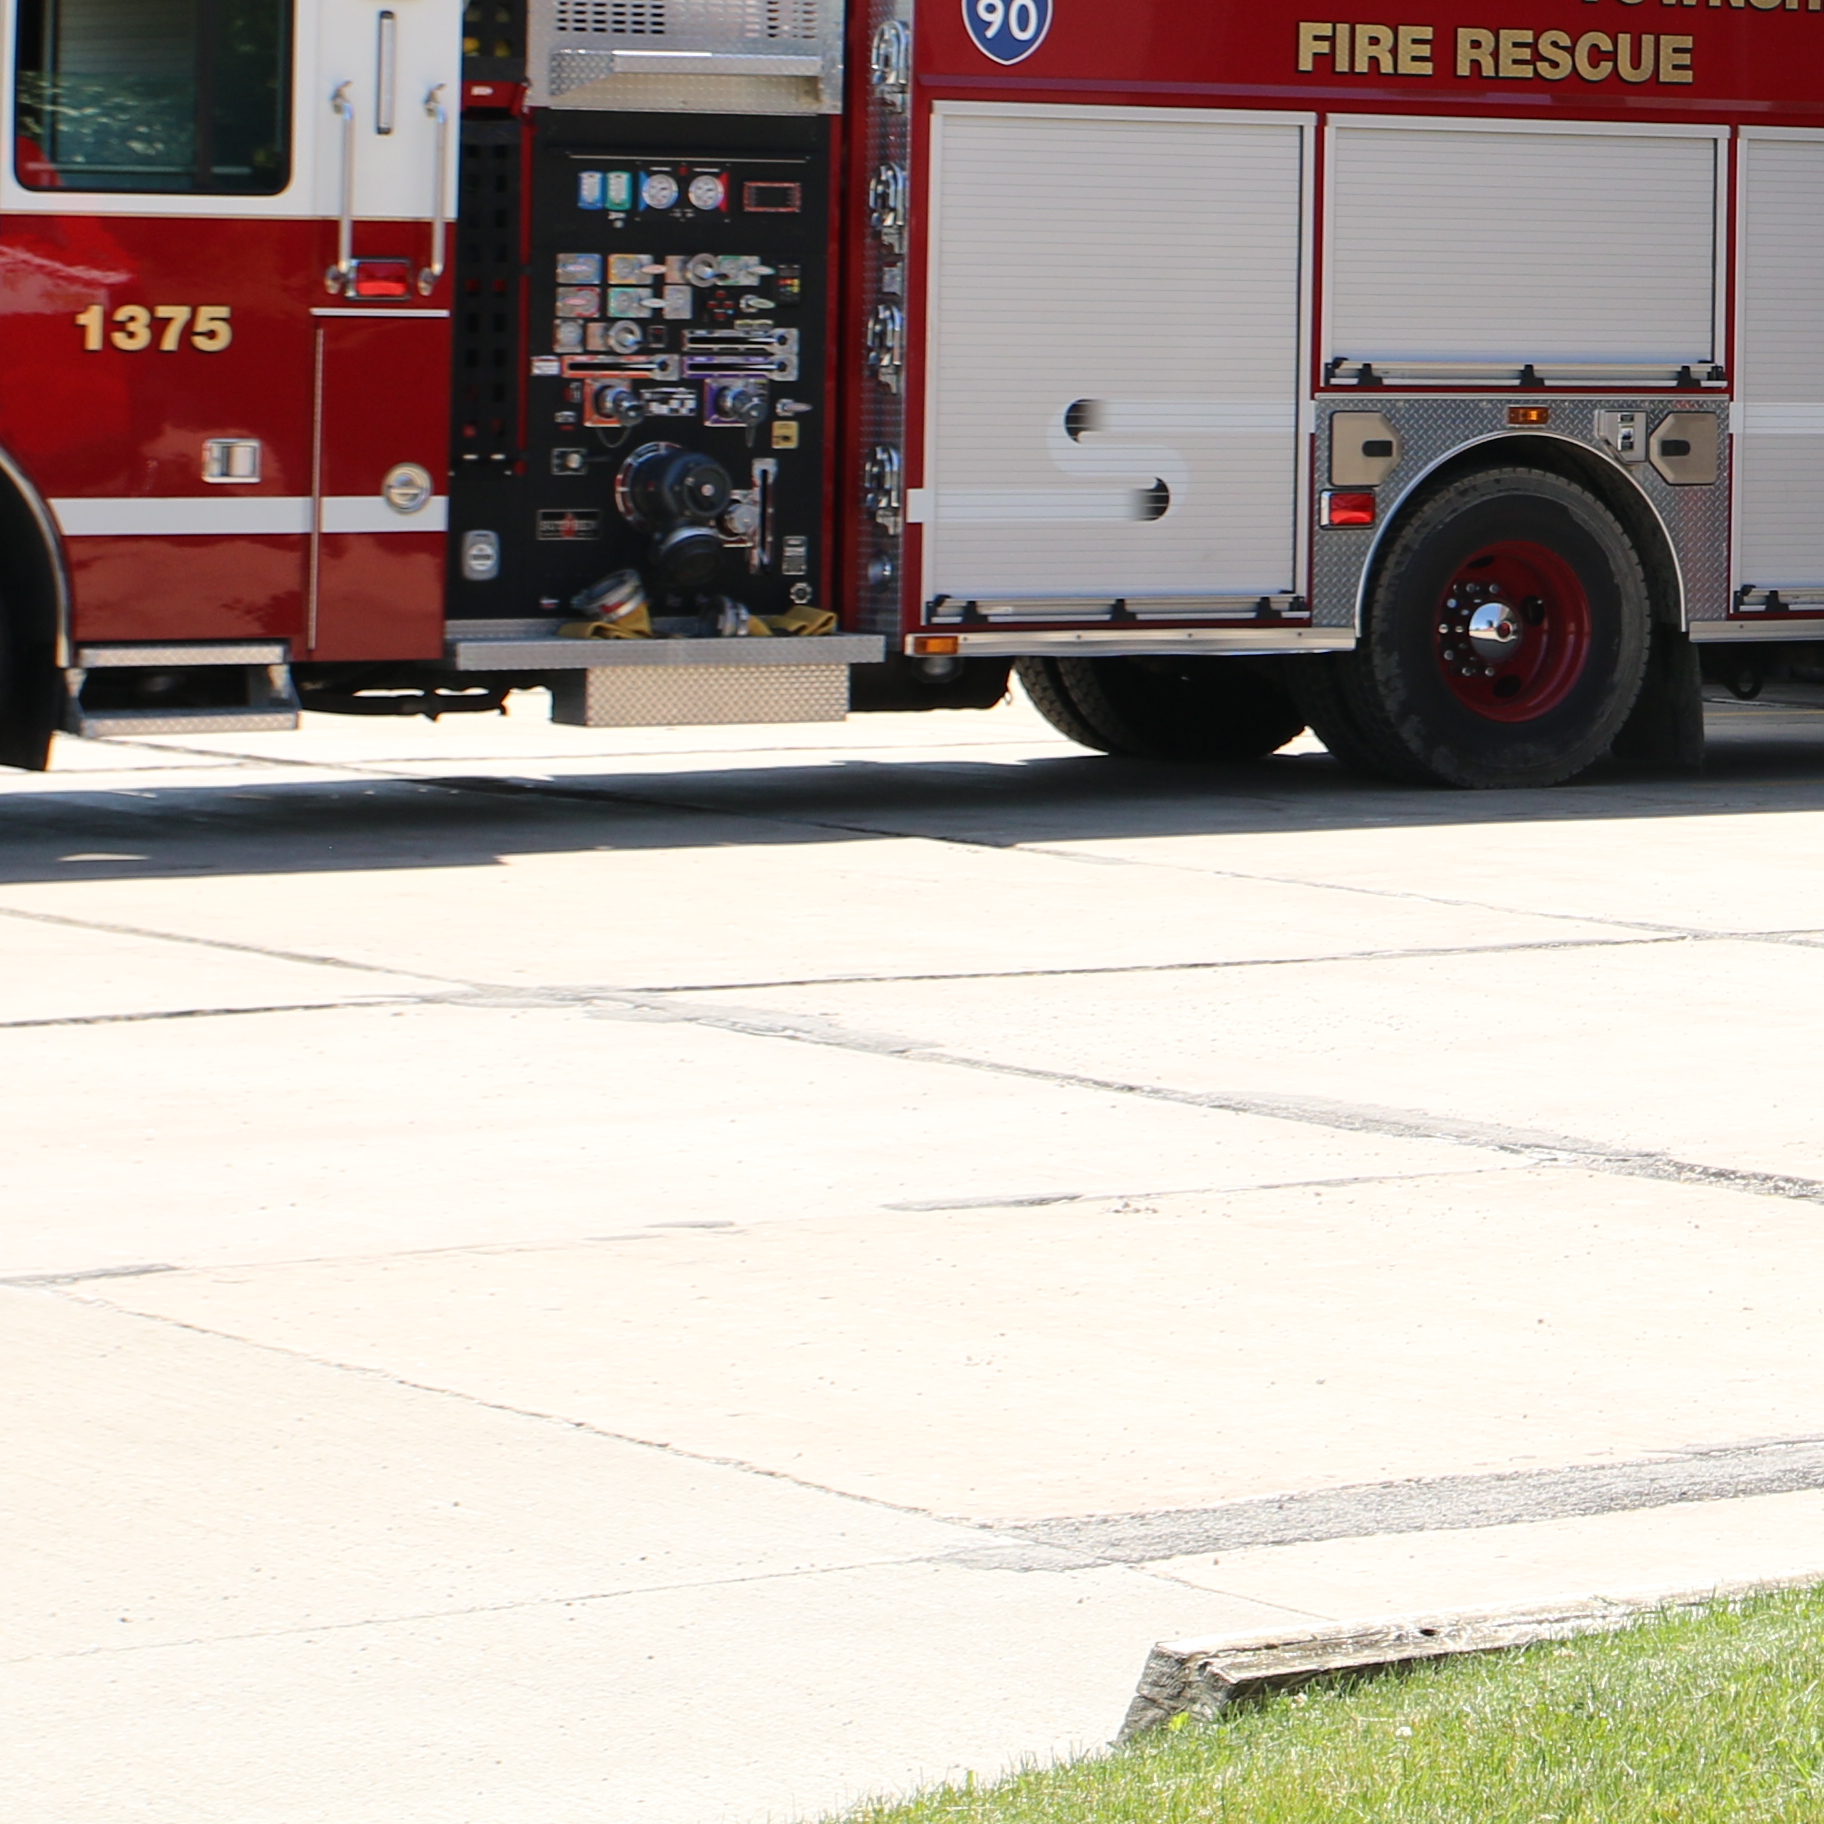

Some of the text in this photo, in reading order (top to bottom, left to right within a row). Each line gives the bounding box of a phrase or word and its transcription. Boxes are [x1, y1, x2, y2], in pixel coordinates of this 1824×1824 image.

[1297, 21, 1694, 85] FIRE RESCUE
[75, 303, 233, 353] 1375
